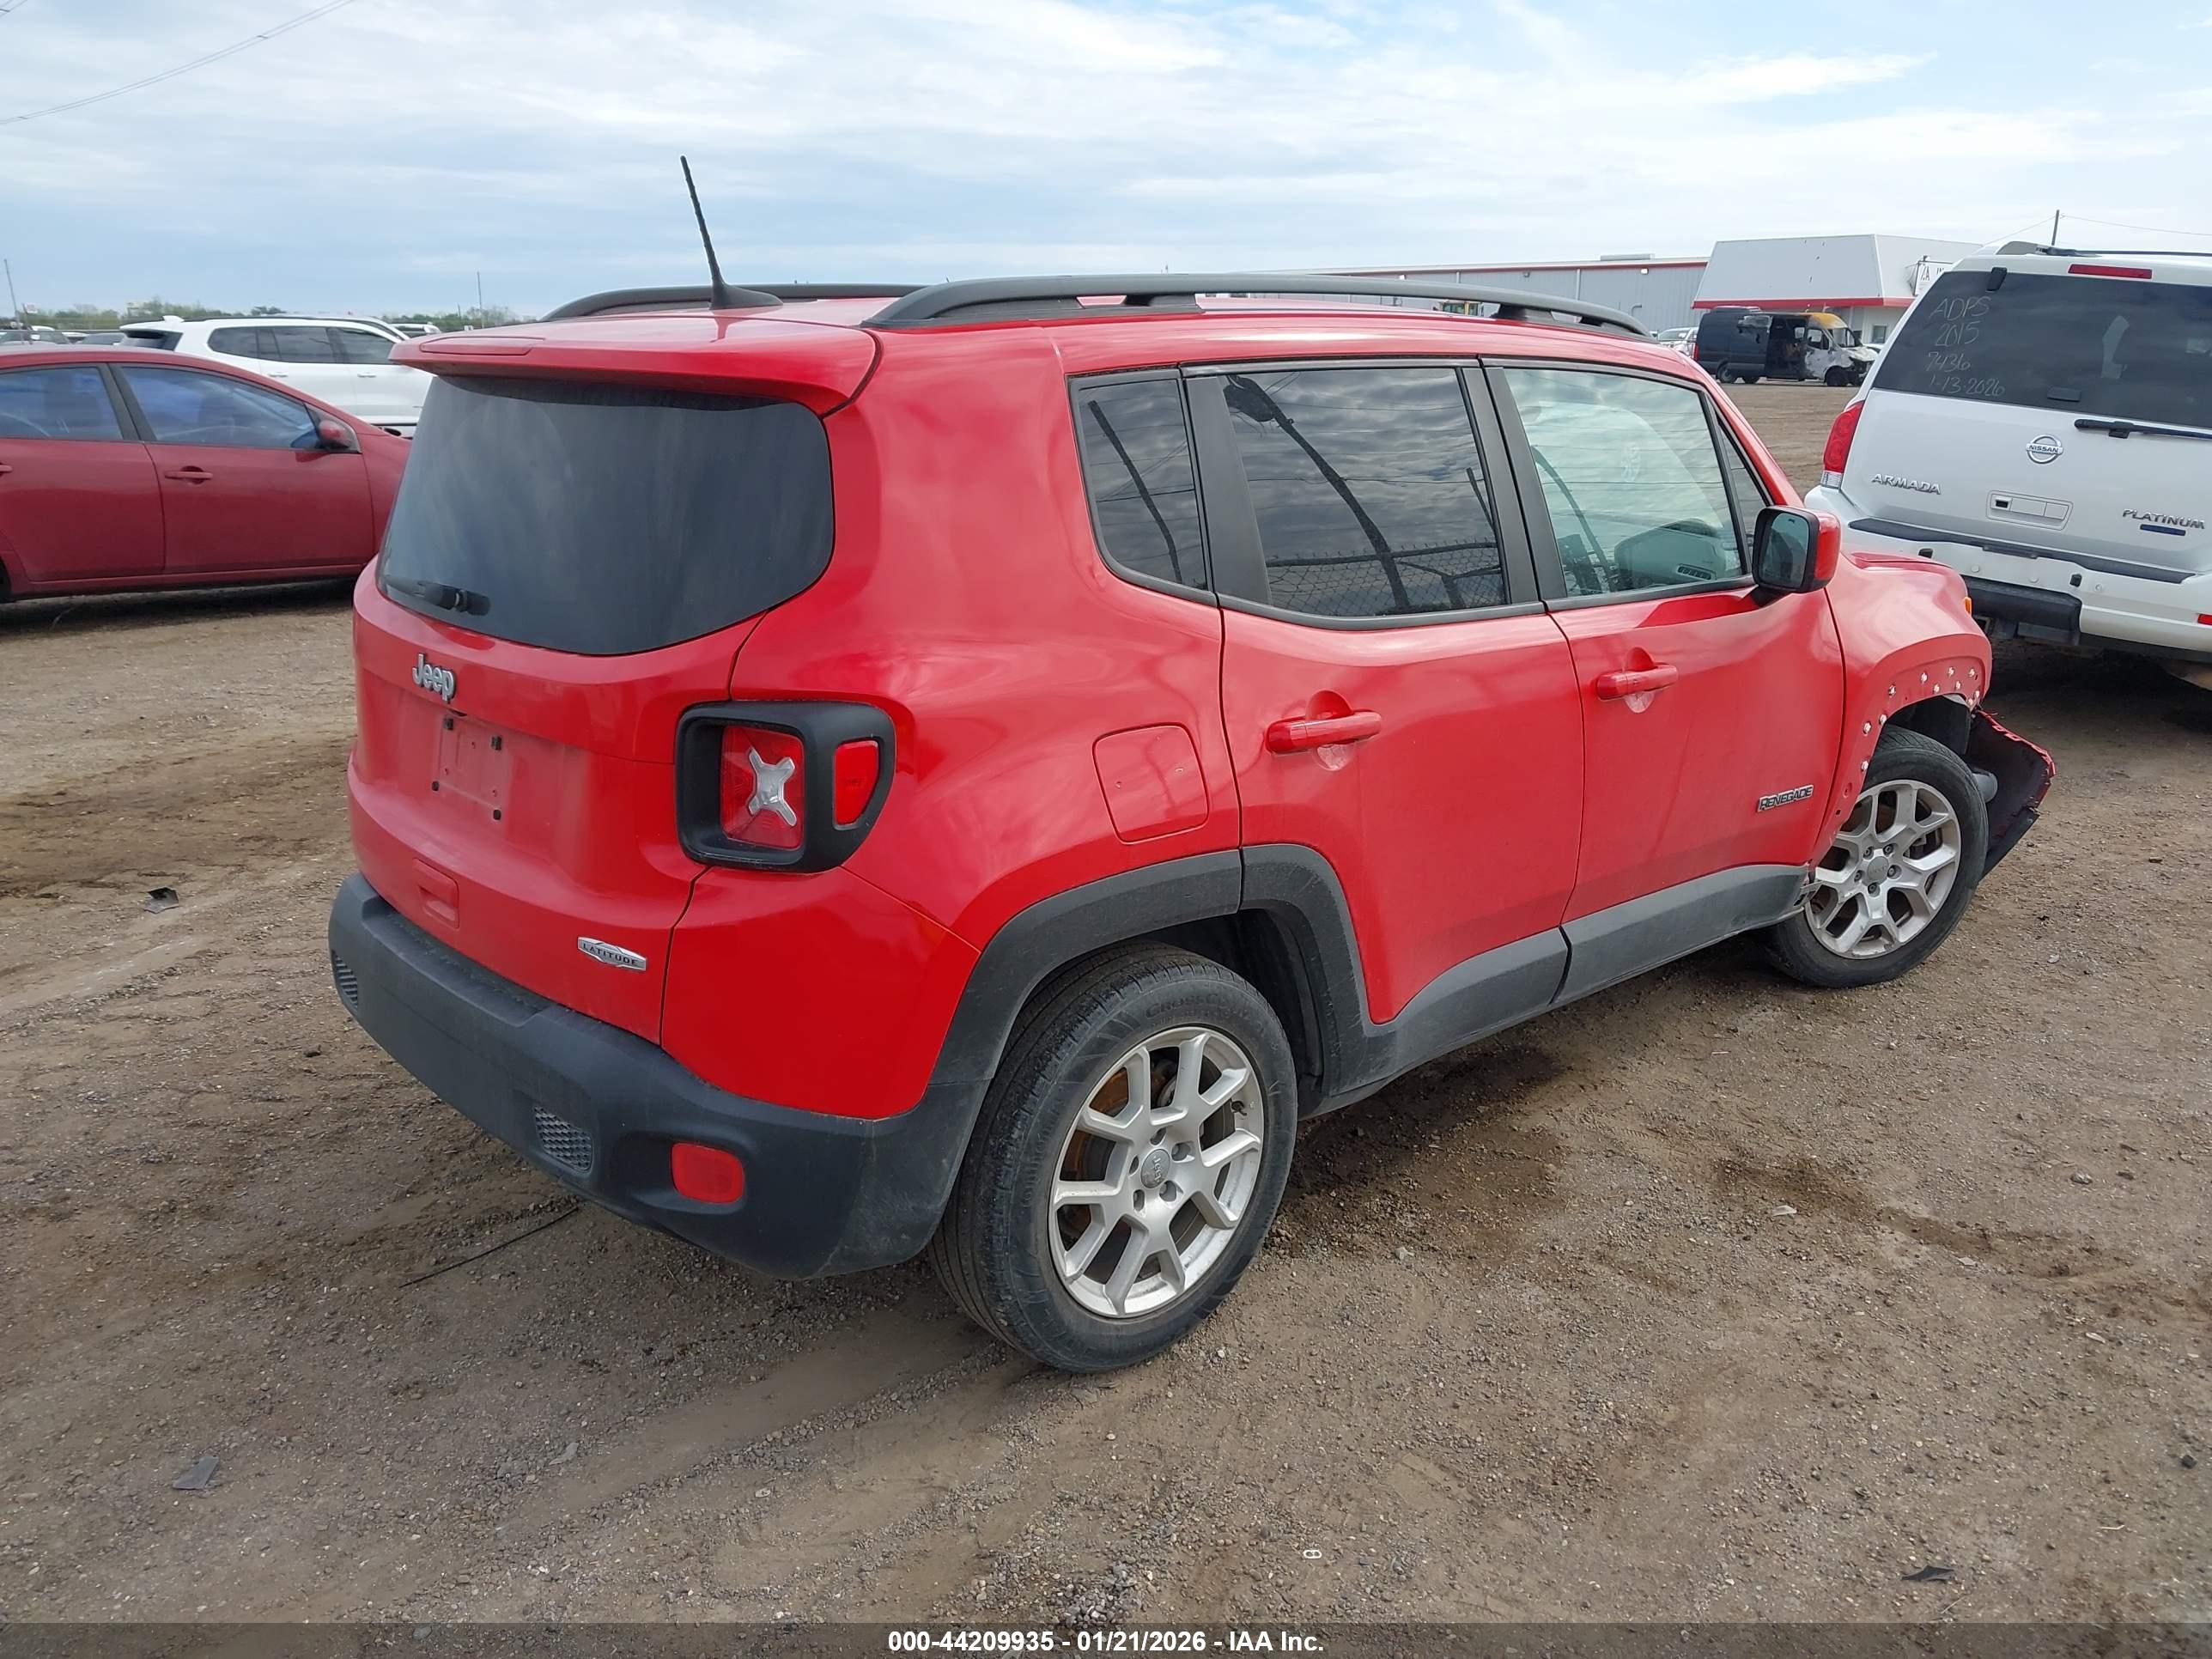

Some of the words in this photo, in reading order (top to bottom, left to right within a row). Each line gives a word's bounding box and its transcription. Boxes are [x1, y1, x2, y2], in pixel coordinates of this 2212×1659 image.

[1935, 320, 1981, 347] 2015
[1926, 351, 1971, 373] 7436
[2029, 445, 2059, 453] NISSAN
[1871, 473, 1942, 495] ARMADA
[2123, 508, 2205, 529] PLATINUM
[411, 653, 456, 702] Jeep
[1758, 785, 1814, 812] RENEGADE
[583, 943, 638, 965] LATITUDE
